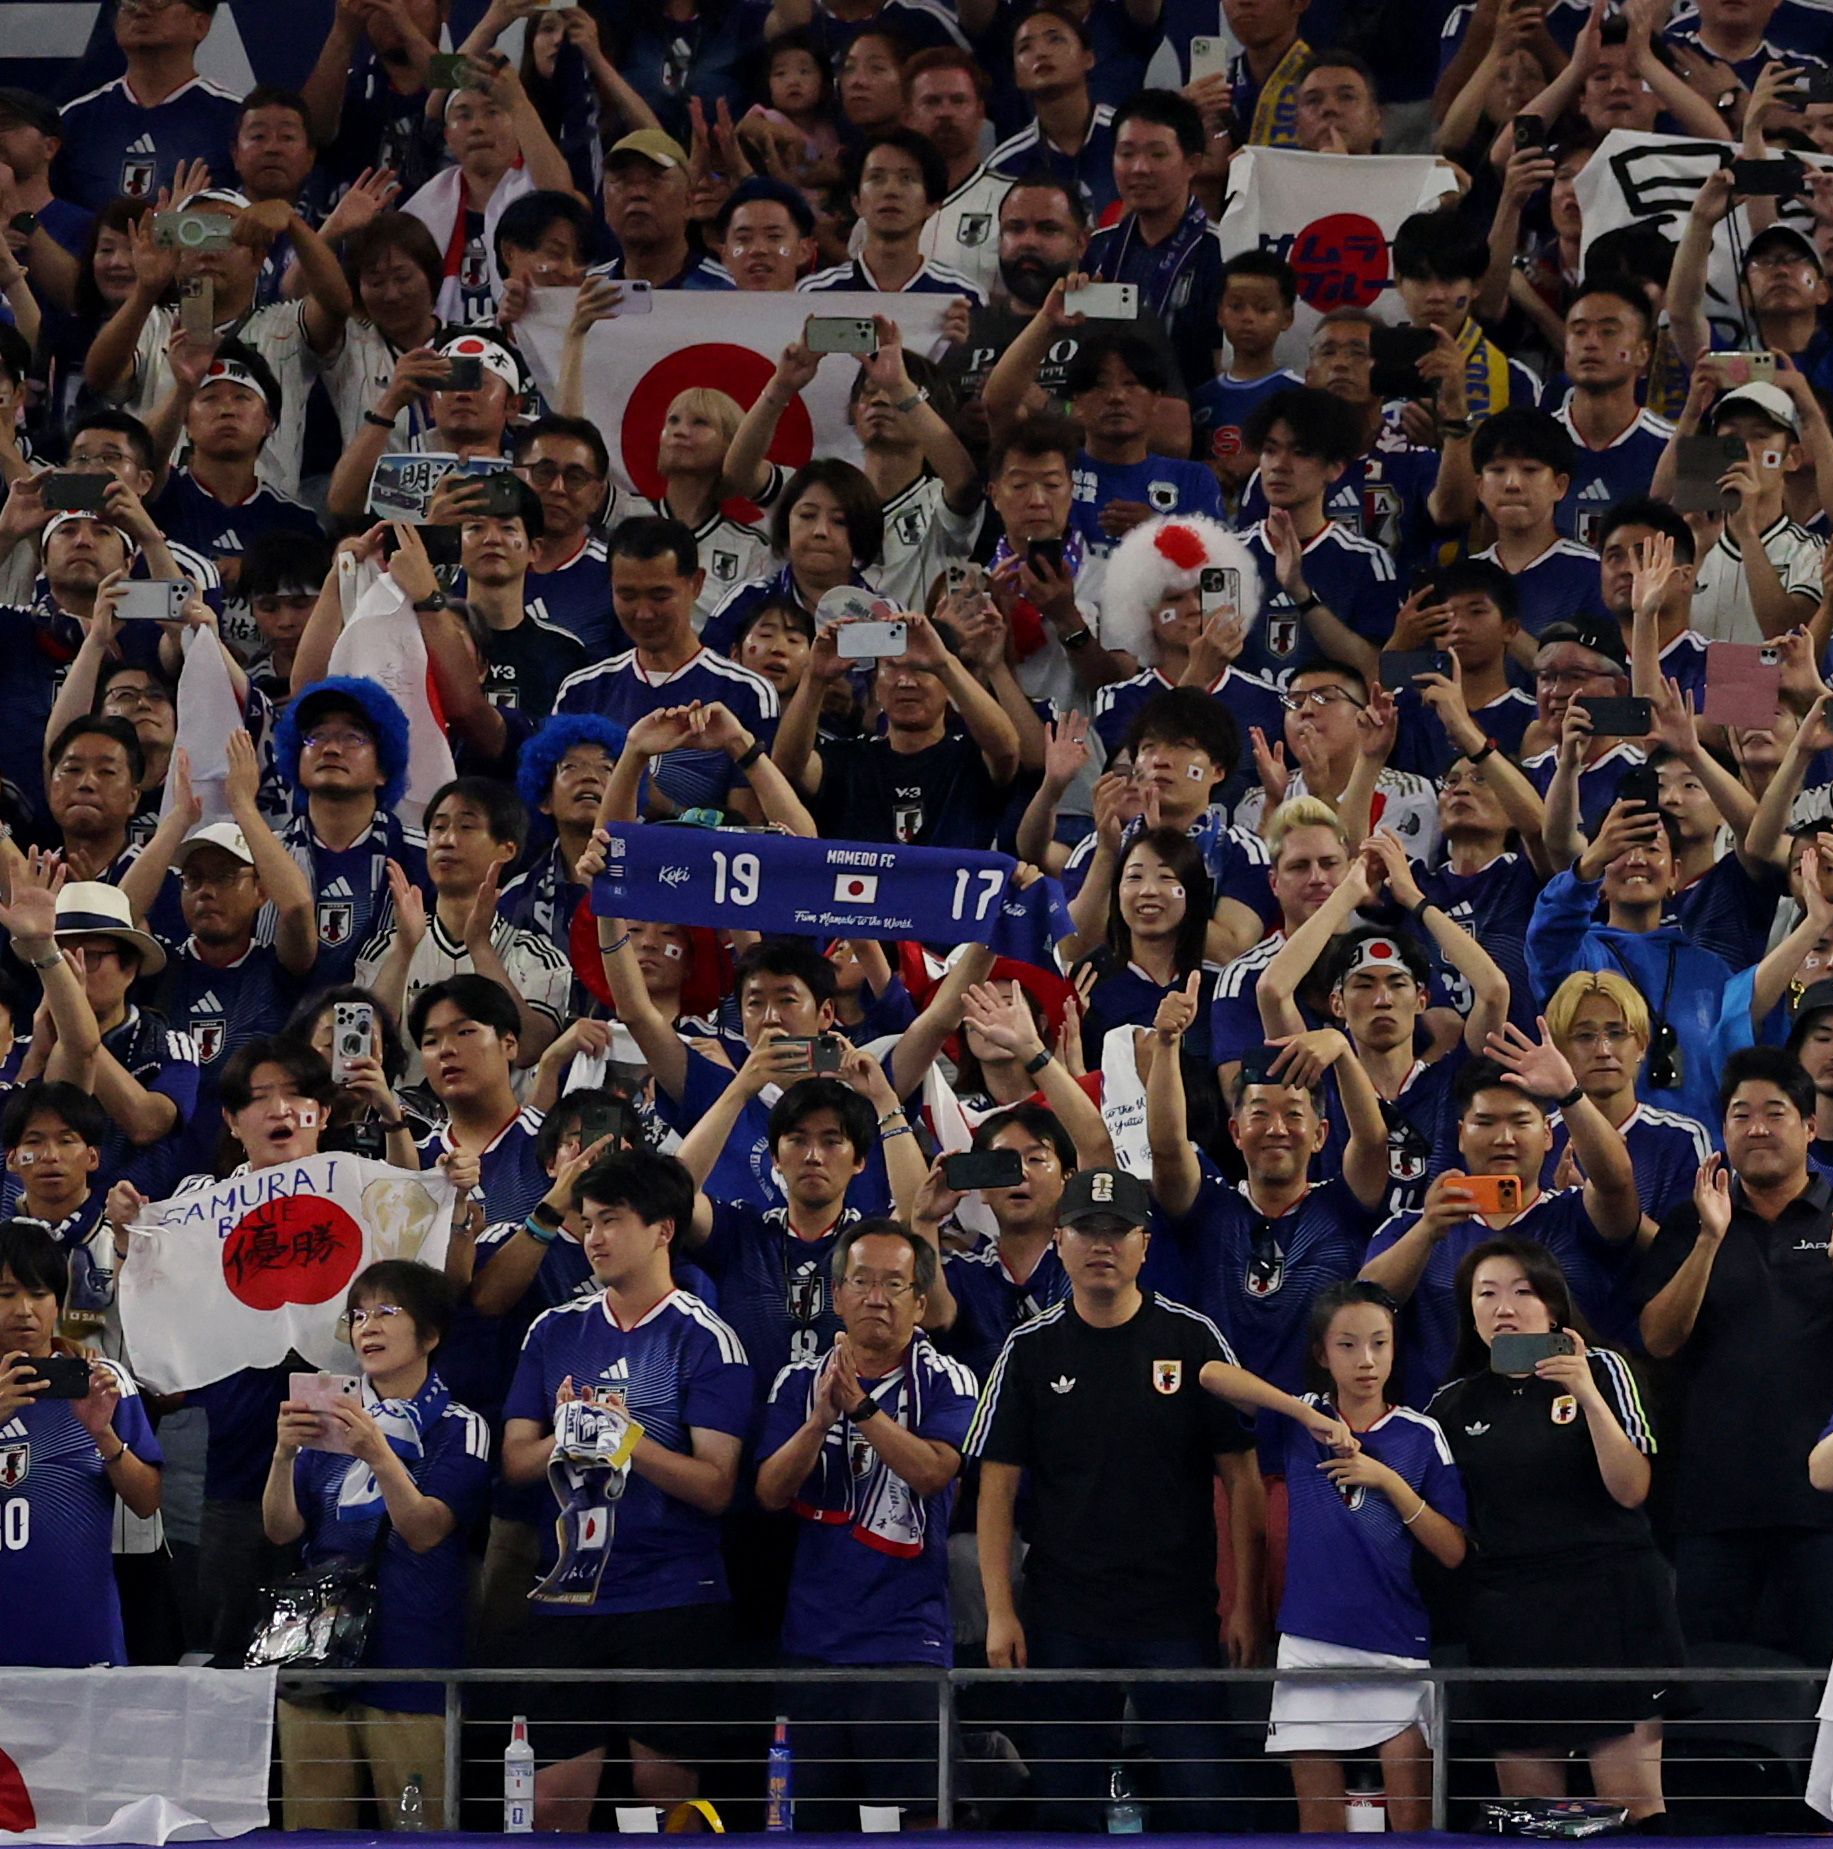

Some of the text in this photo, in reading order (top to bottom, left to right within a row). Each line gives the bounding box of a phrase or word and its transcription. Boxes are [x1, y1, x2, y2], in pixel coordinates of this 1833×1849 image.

[971, 345, 1076, 371] PO
[490, 664, 516, 680] Y-3
[895, 787, 921, 799] Y-3
[825, 850, 895, 868] MAMEDO FC
[657, 864, 690, 891] Koki
[712, 850, 760, 907] 19
[951, 867, 1004, 921] 17
[792, 909, 816, 923] From
[818, 910, 851, 926] Mamedo
[852, 913, 868, 926] to
[868, 913, 883, 926] the
[158, 1160, 337, 1229] SAMURAI
[216, 1201, 302, 1240] BLUE
[222, 1220, 345, 1286] 優勝
[0, 1496, 30, 1552] 0
